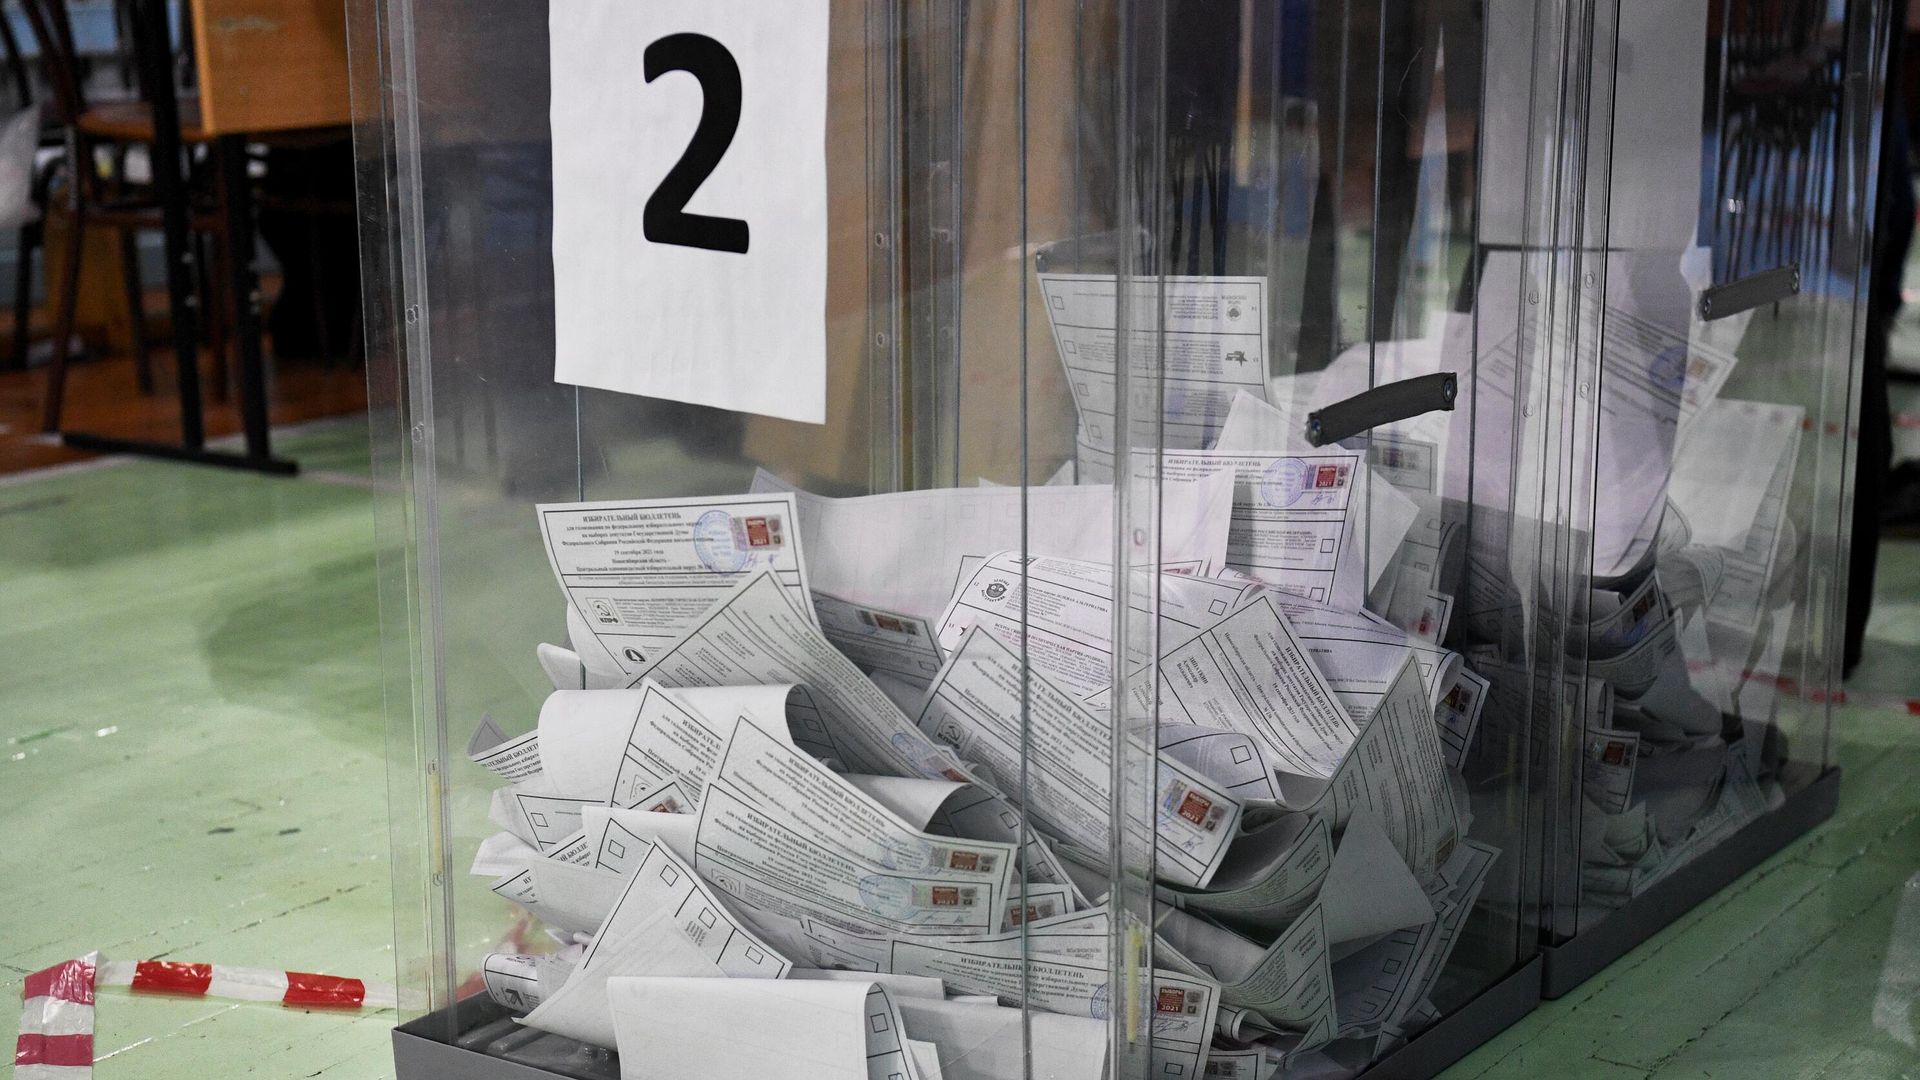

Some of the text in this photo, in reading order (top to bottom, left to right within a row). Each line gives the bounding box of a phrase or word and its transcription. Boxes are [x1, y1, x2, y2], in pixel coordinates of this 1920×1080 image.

[643, 33, 749, 255] 2
[582, 512, 682, 523] ИЗБИРАТЕЛЬНЫЙ БЮЛЛЕТЕНЬ
[1284, 646, 1320, 697] ИЗБИРАТЕЛЬНЫЙ
[1315, 695, 1340, 729] БЮЛЛЕТЕНЬ
[1181, 811, 1201, 822] 2021
[746, 812, 856, 873] ИЗБИРАТЕЛЬНЫЙ БЮЛЛЕТЕНЬ
[1032, 965, 1085, 979] БЮЛЛЕТЕНЬ
[1161, 988, 1183, 996] ВЫБОРЫ
[1160, 1004, 1180, 1012] 2021
